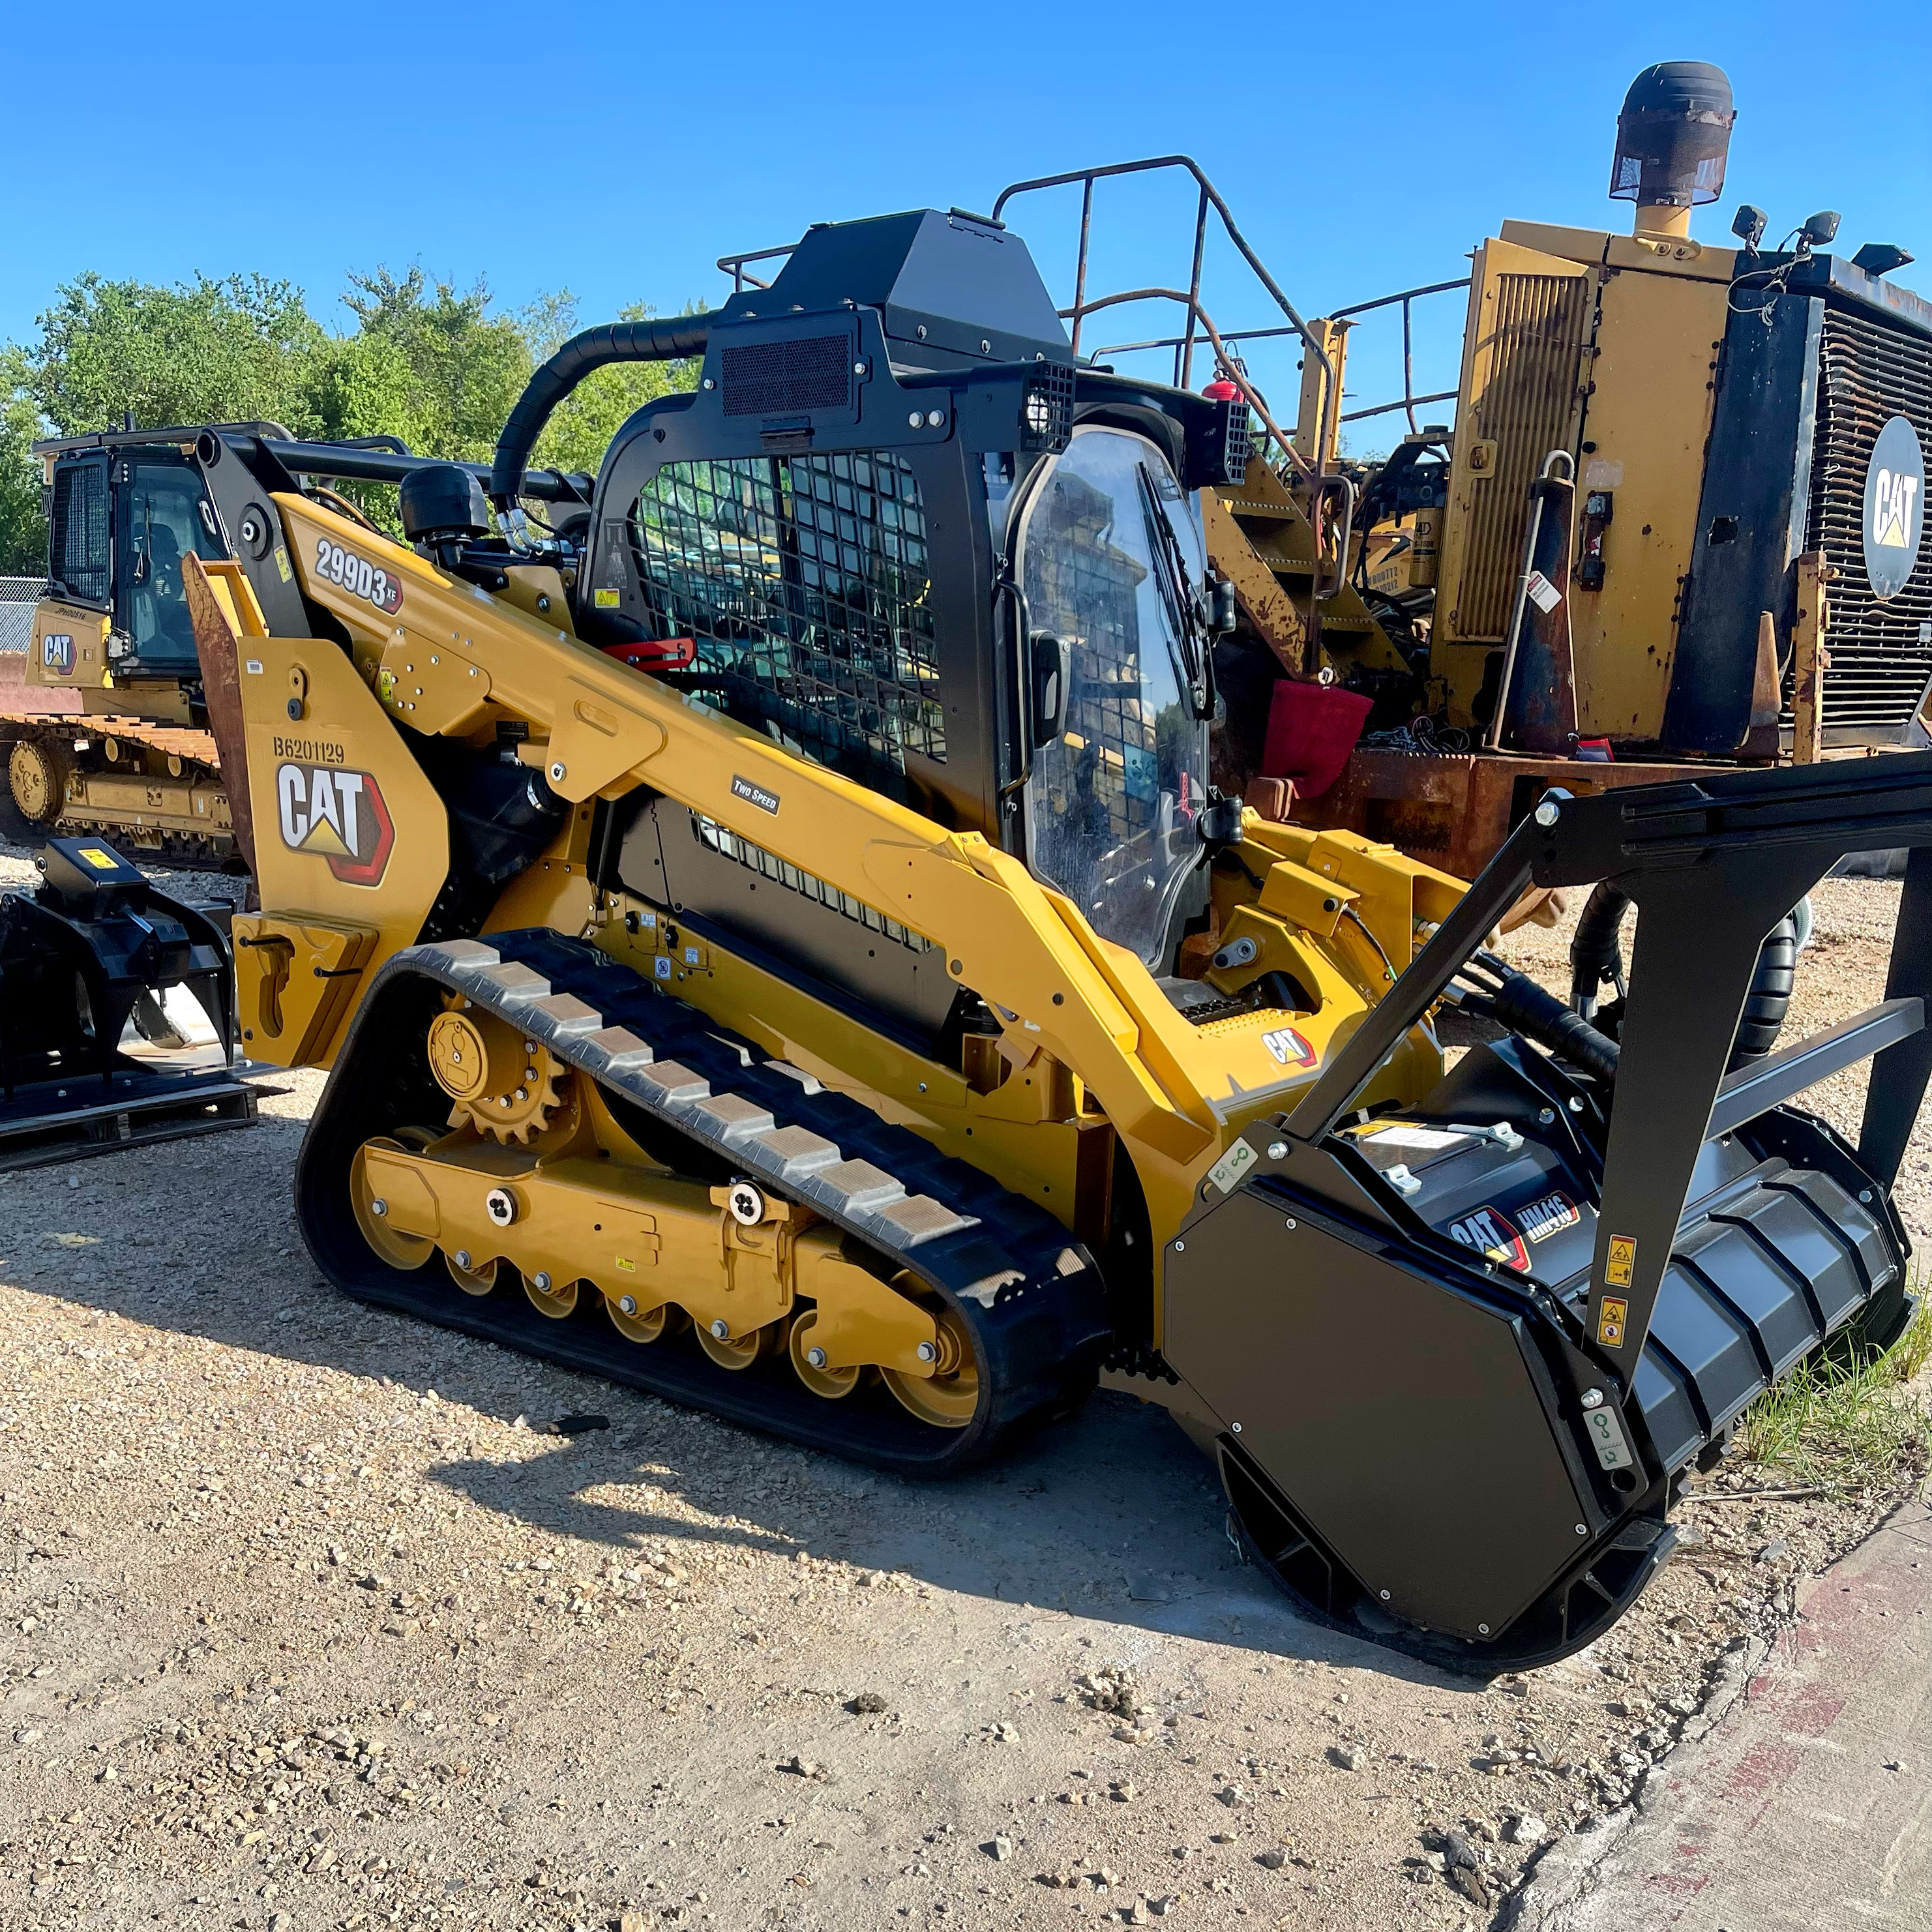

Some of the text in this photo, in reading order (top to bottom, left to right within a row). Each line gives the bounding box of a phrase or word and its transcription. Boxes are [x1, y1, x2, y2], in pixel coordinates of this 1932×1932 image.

[1873, 468, 1918, 548] CAT
[316, 540, 387, 606] 299D3
[387, 587, 396, 602] XE
[45, 636, 69, 666] CAT
[273, 736, 344, 764] B6201129
[278, 764, 363, 857] CAT
[1262, 1029, 1306, 1064] CAT
[1517, 1195, 1573, 1240] HM416
